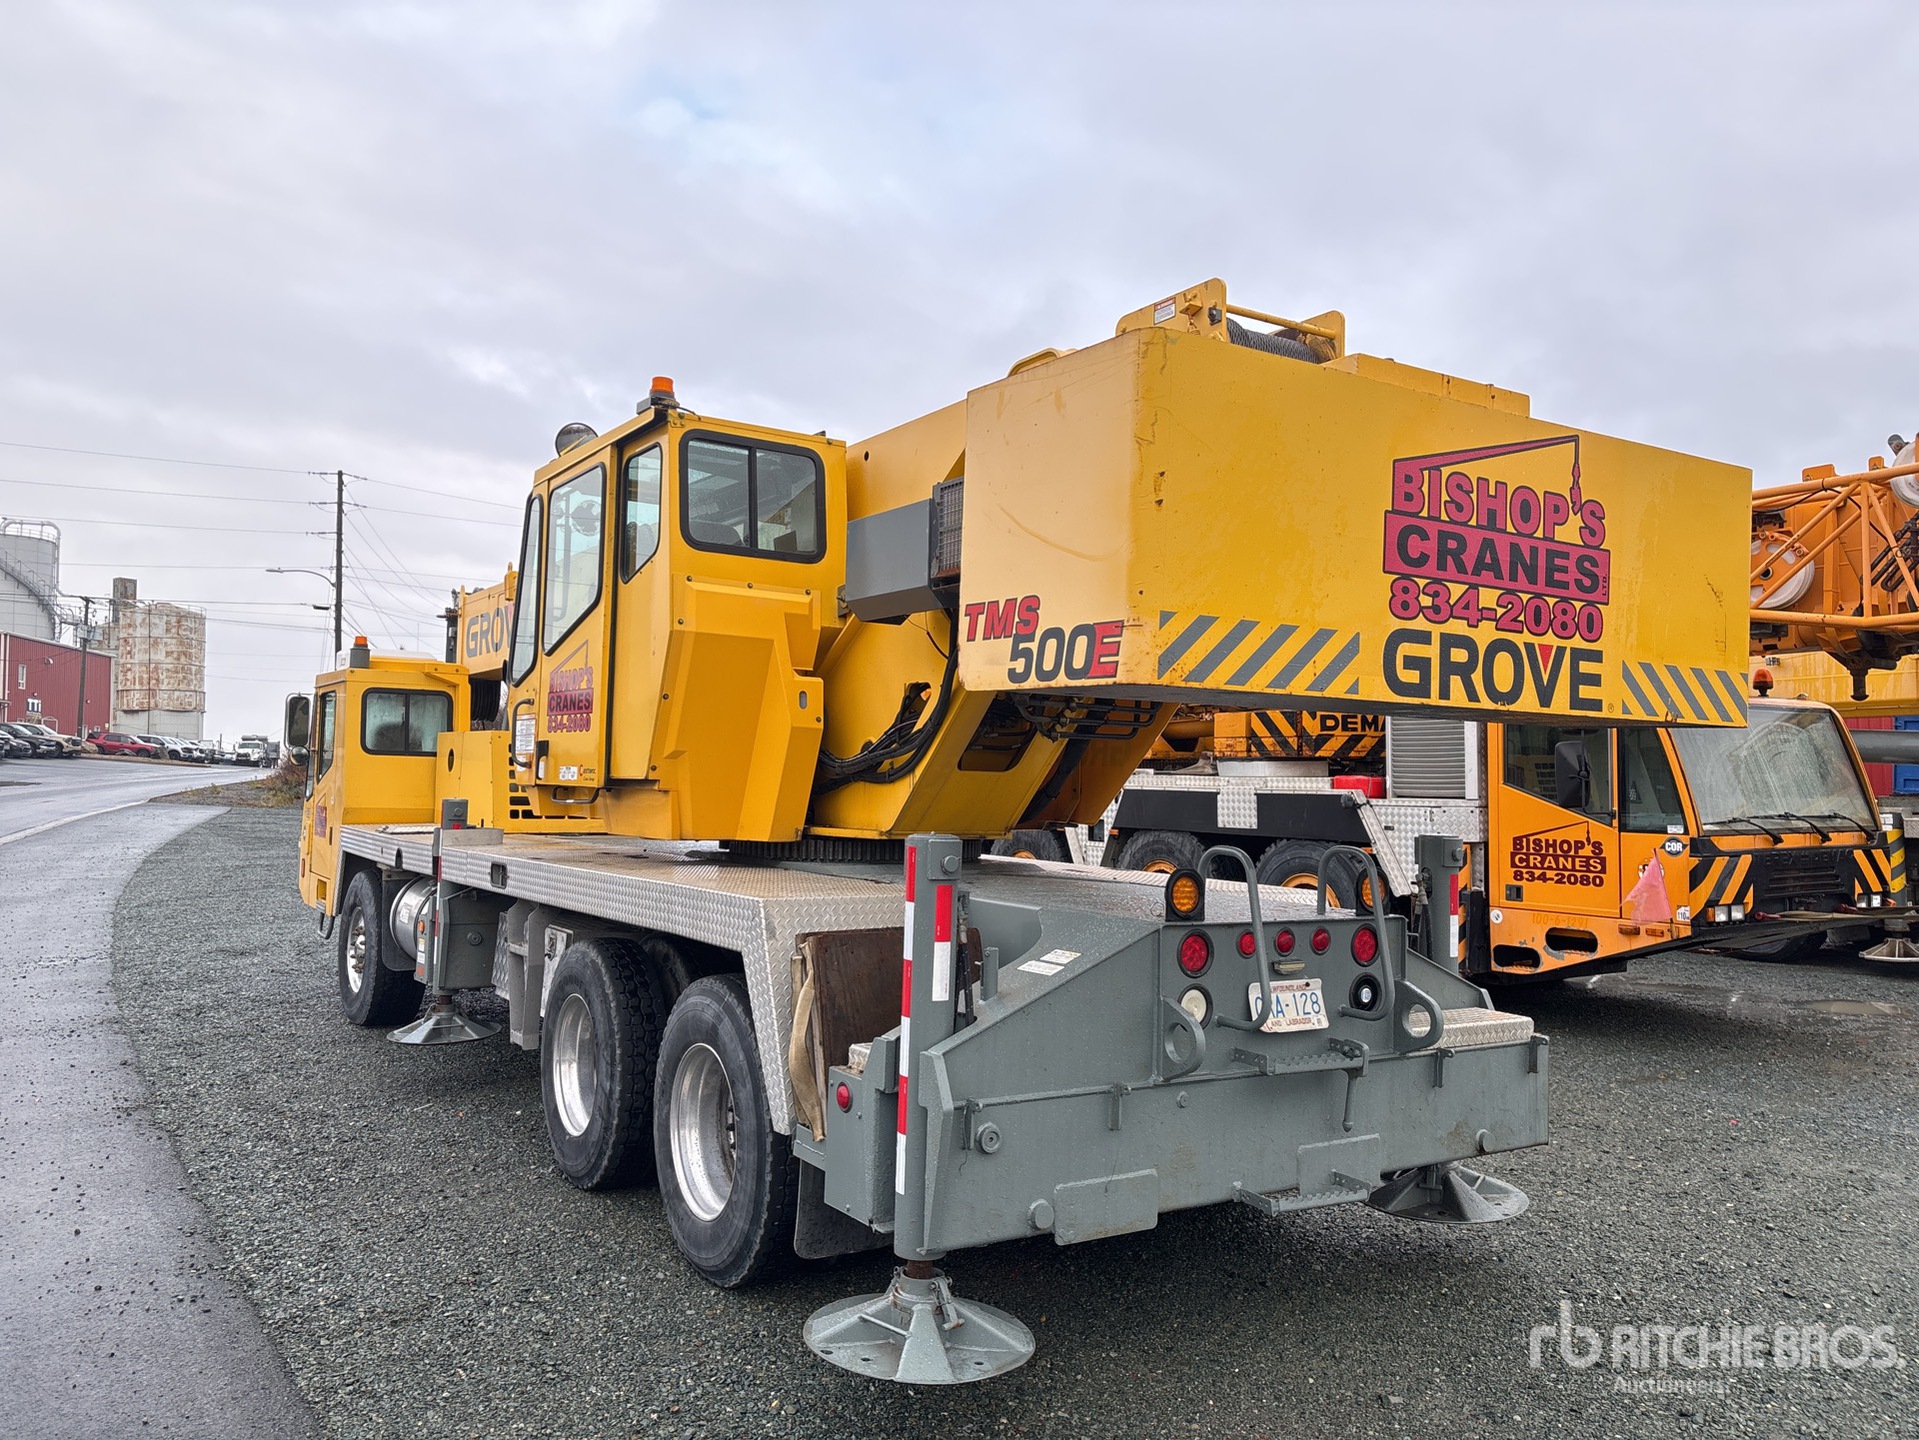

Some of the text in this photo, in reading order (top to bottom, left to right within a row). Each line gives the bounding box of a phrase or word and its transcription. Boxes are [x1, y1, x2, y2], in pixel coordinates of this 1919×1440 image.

[1393, 463, 1606, 548] BISHOP'S
[1396, 524, 1600, 594] CRANES
[964, 594, 1041, 642] TMS
[1389, 576, 1604, 642] 834-2080
[1008, 619, 1125, 684] 500E
[549, 666, 594, 692] BISHOP'S
[1382, 627, 1604, 712] GROVE
[549, 692, 591, 713] CRANES
[547, 713, 592, 733] 834-2080
[1320, 714, 1386, 732] DEM
[1512, 837, 1604, 856] BISHOP'S
[1665, 842, 1683, 852] COR
[1514, 853, 1602, 871] CRANES
[1512, 870, 1605, 888] 834-2080
